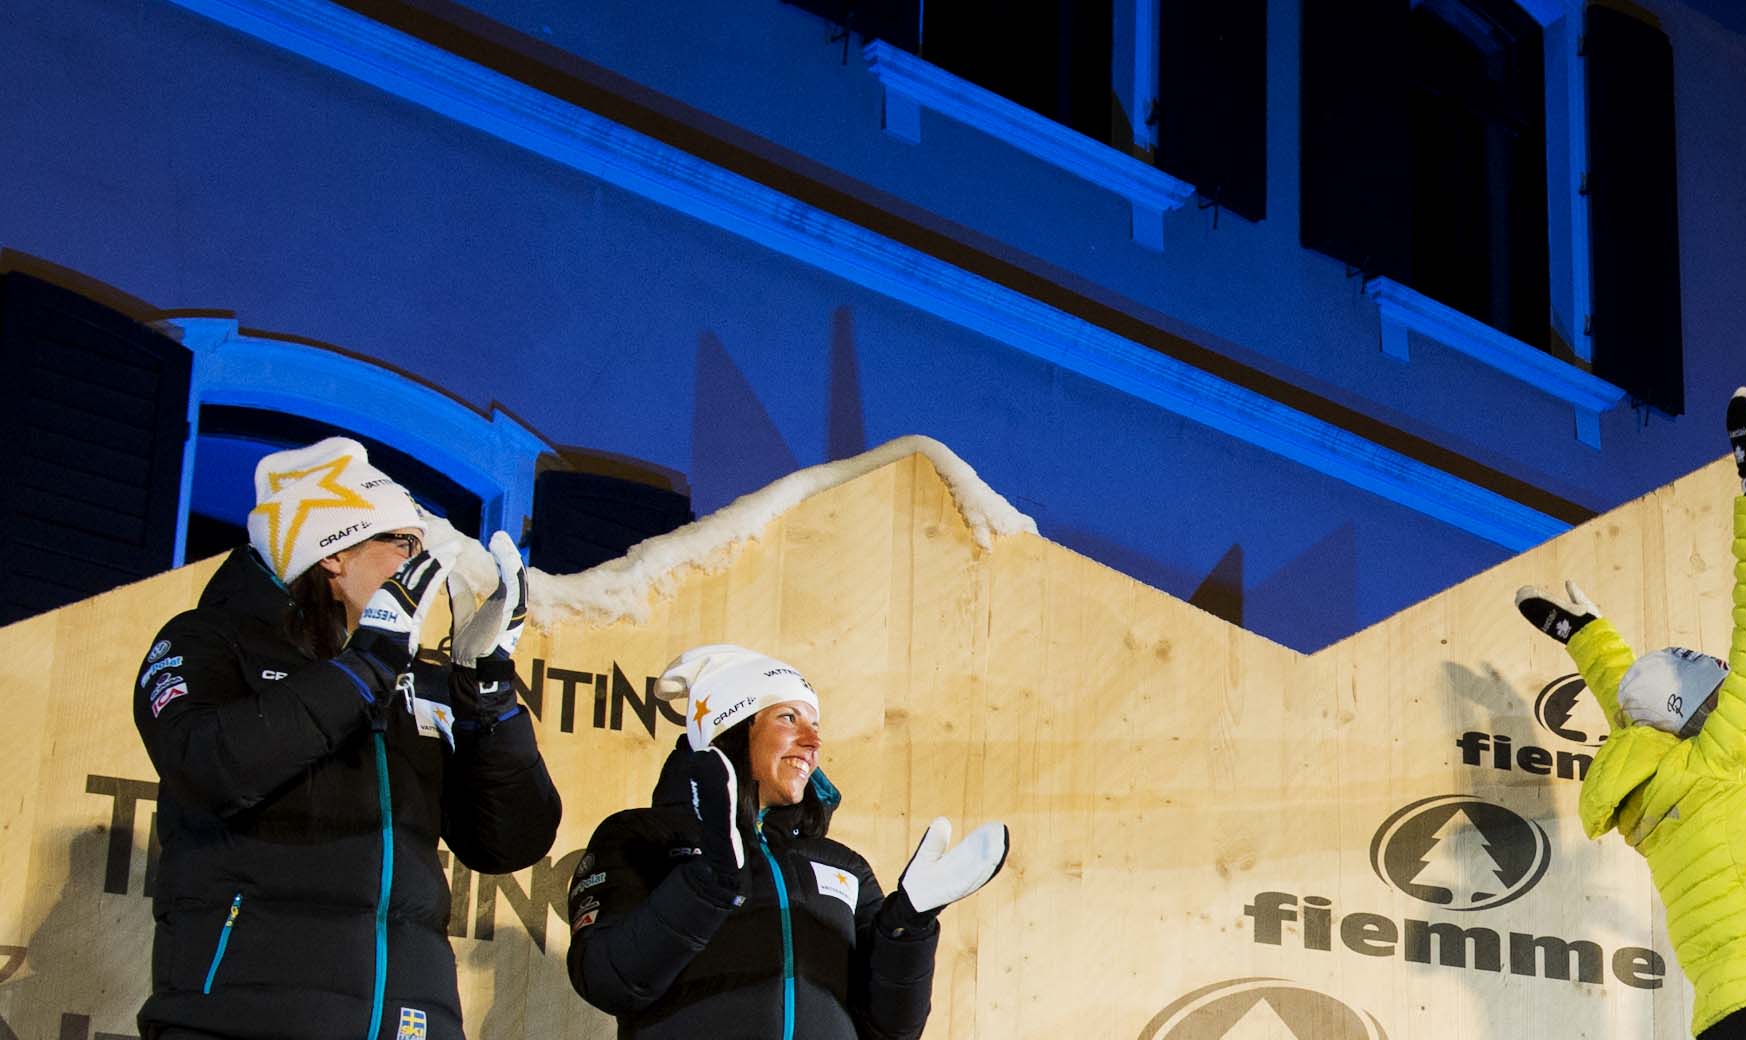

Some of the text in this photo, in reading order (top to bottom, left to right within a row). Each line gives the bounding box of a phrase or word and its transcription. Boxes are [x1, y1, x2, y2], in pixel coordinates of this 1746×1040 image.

[319, 522, 360, 548] CRAFT
[712, 699, 746, 726] CRAFT
[1456, 731, 1594, 782] fie
[1243, 891, 1666, 990] fiemme
